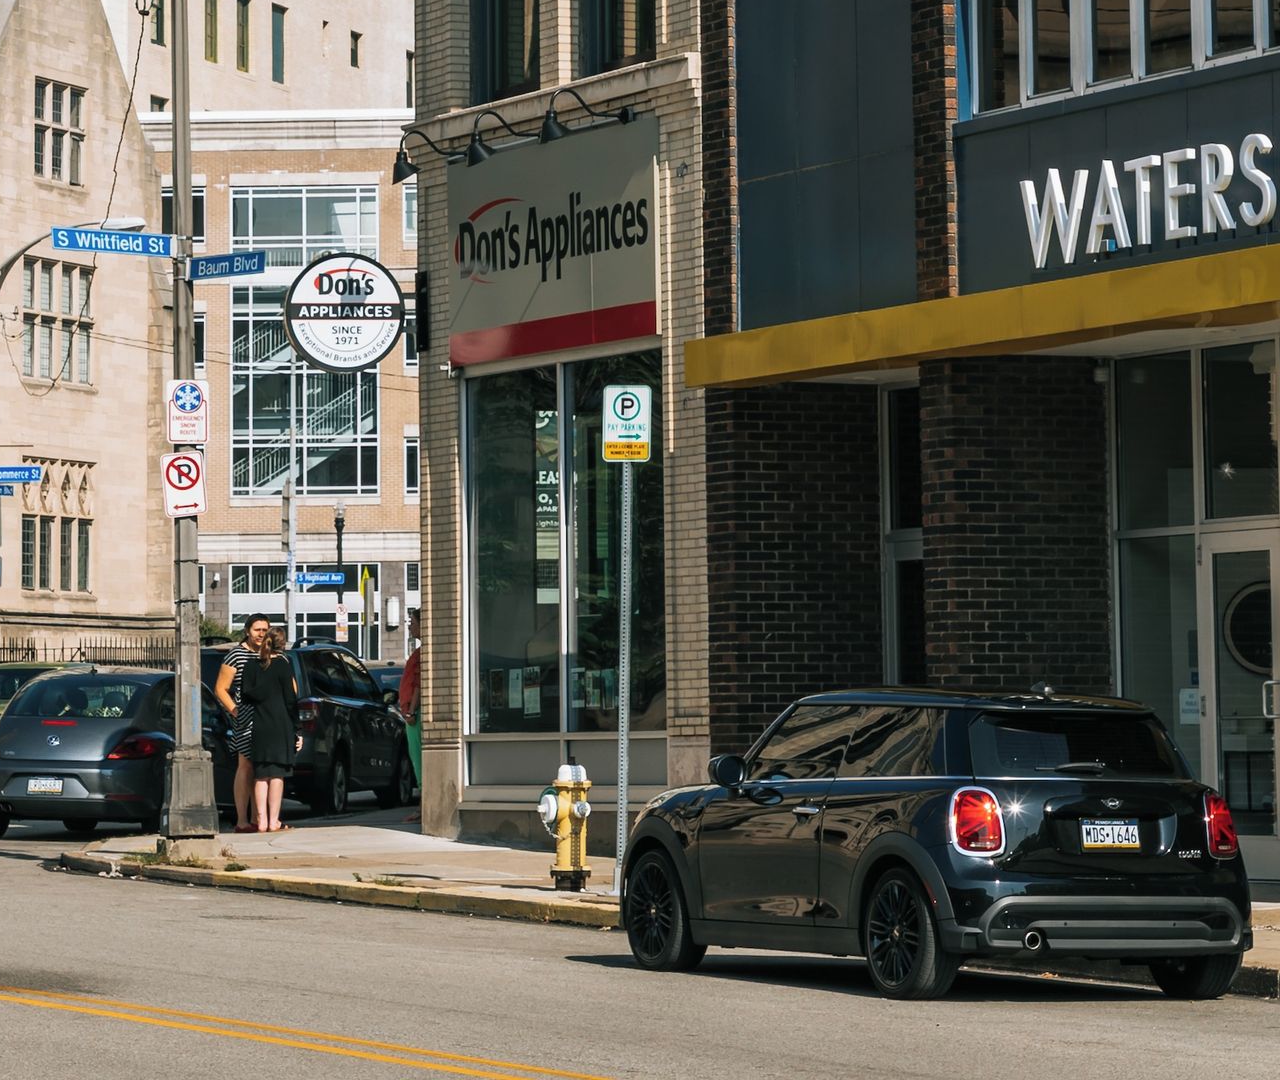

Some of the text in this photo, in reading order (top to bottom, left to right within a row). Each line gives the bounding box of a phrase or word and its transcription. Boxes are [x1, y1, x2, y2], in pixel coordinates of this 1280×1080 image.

[57, 230, 165, 253] S Whitfield St
[459, 191, 649, 283] Don's Appliances
[198, 254, 259, 276] Baum Blvd
[318, 272, 374, 296] Don's
[299, 305, 393, 318] APPLIANCES
[331, 325, 362, 335] SINCE
[299, 322, 395, 362] Exceptional Brands and Service
[335, 336, 359, 345] 1971
[621, 397, 635, 416] P
[608, 423, 647, 431] PAY PARKING
[331, 573, 342, 581] Ave
